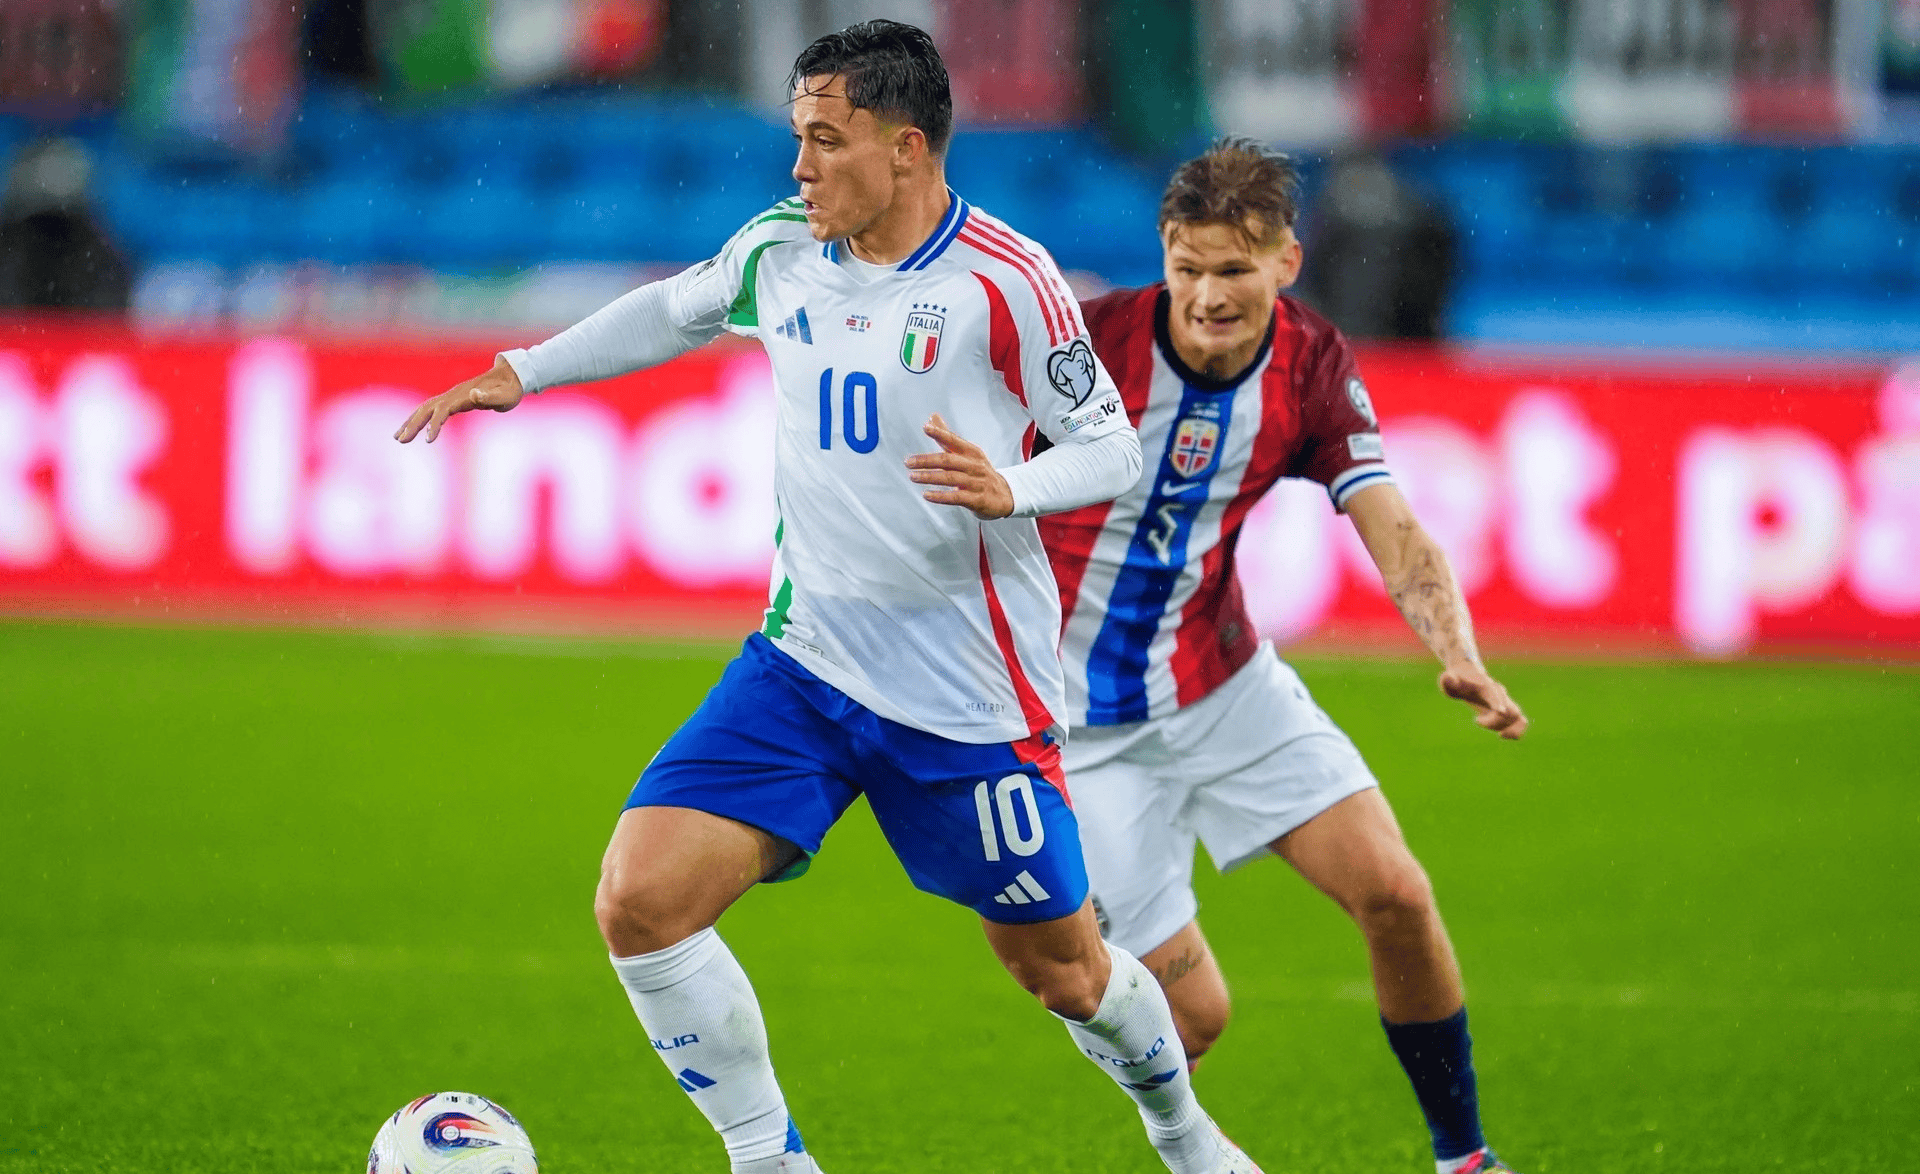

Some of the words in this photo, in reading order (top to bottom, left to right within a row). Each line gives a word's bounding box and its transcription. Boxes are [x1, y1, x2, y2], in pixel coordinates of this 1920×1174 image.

[909, 316, 939, 331] ITALIA
[819, 367, 880, 455] 10
[974, 773, 1045, 862] 10
